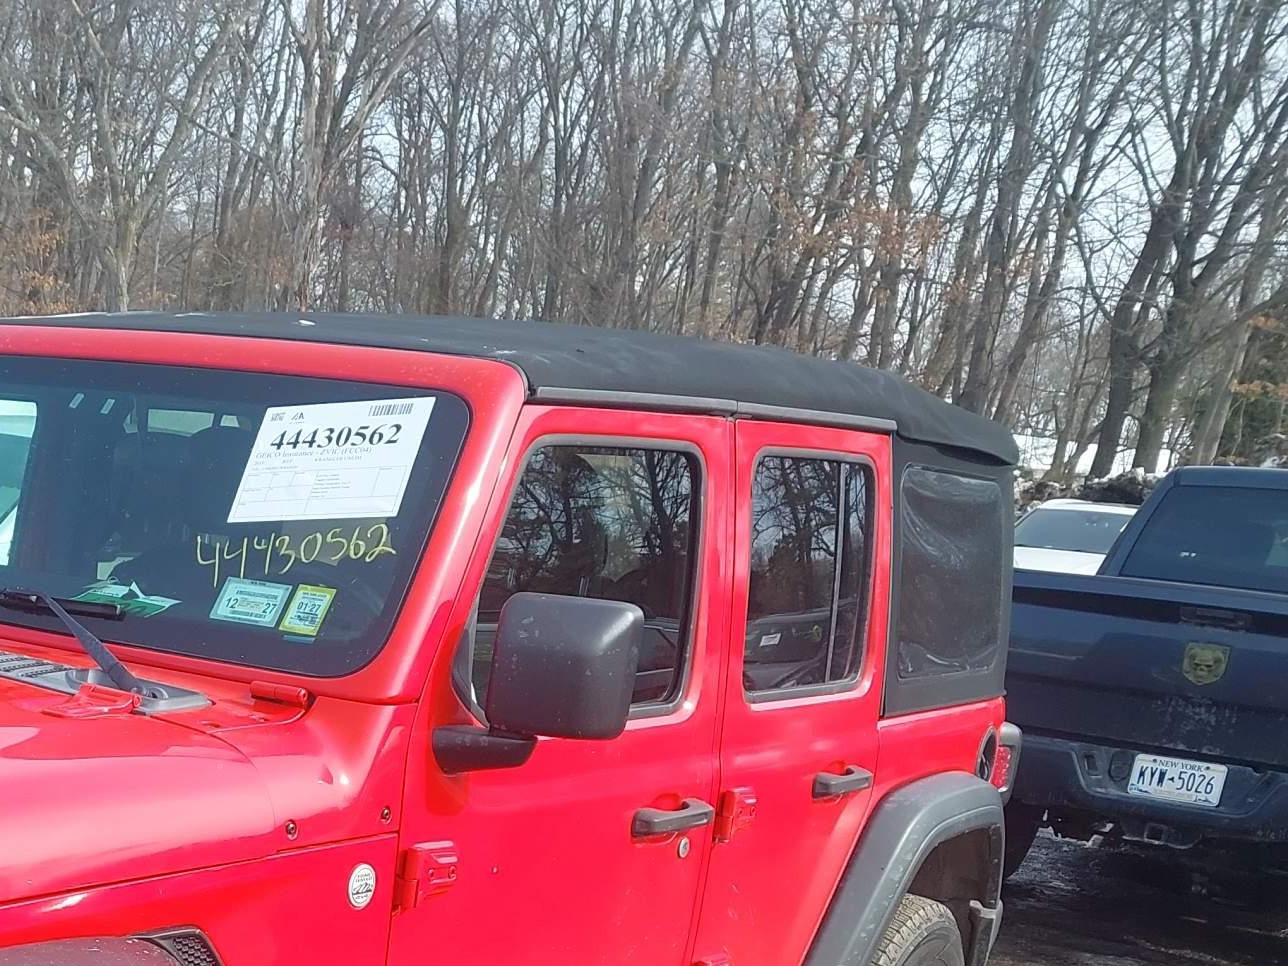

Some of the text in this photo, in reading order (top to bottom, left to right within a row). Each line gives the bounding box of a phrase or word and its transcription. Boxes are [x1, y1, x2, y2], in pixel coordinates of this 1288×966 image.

[270, 423, 403, 450] 44430562
[195, 523, 397, 588] 44430562
[225, 597, 278, 614] 12 27
[1158, 759, 1203, 772] NEW YORK
